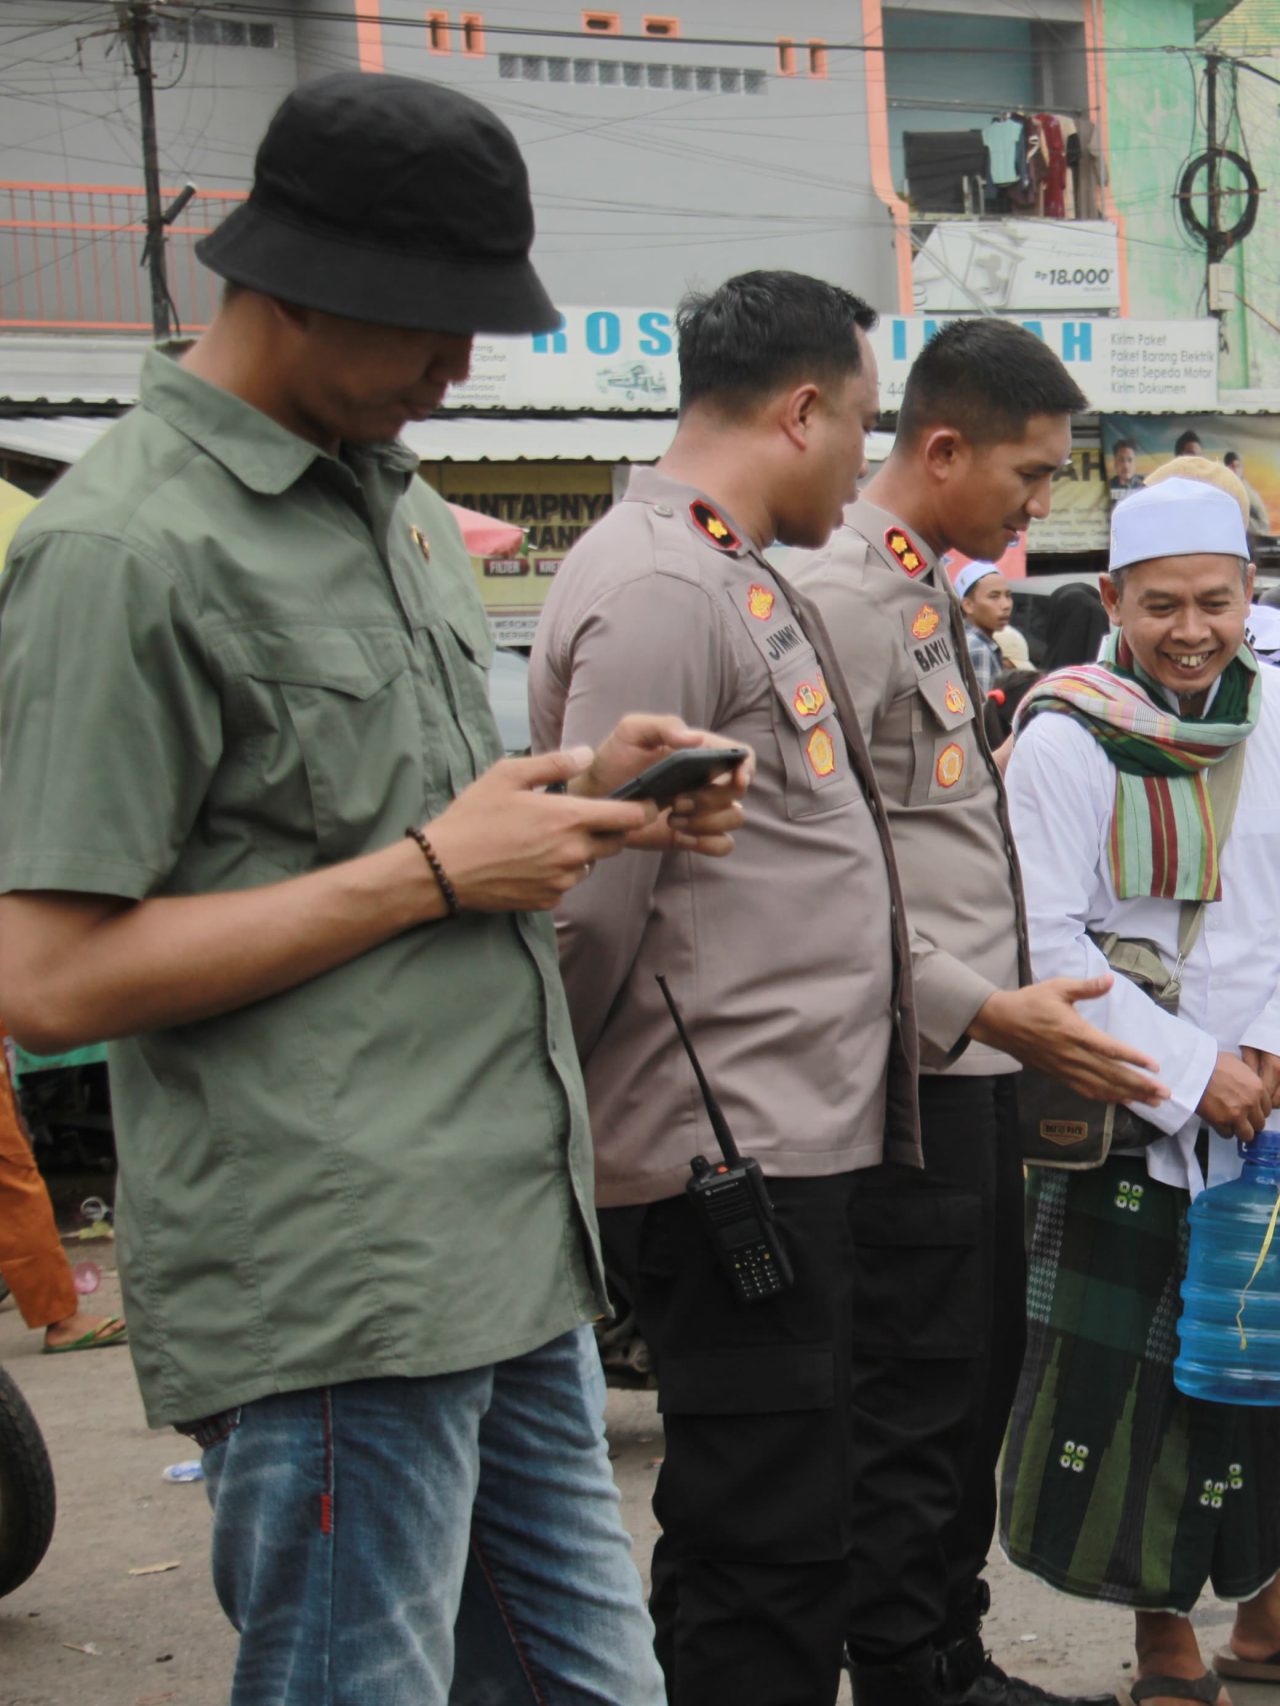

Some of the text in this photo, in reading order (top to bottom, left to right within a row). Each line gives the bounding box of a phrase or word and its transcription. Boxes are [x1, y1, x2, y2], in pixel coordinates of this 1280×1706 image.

[1111, 333, 1167, 345] Kirim Paket
[1111, 349, 1139, 361] Paket
[1142, 349, 1177, 365] Barang
[1111, 366, 1212, 380] Paket Sepeda Motor
[1111, 382, 1186, 394] Kirim Dokumen
[765, 624, 804, 661] JIMMY
[914, 638, 950, 673] BAYU
